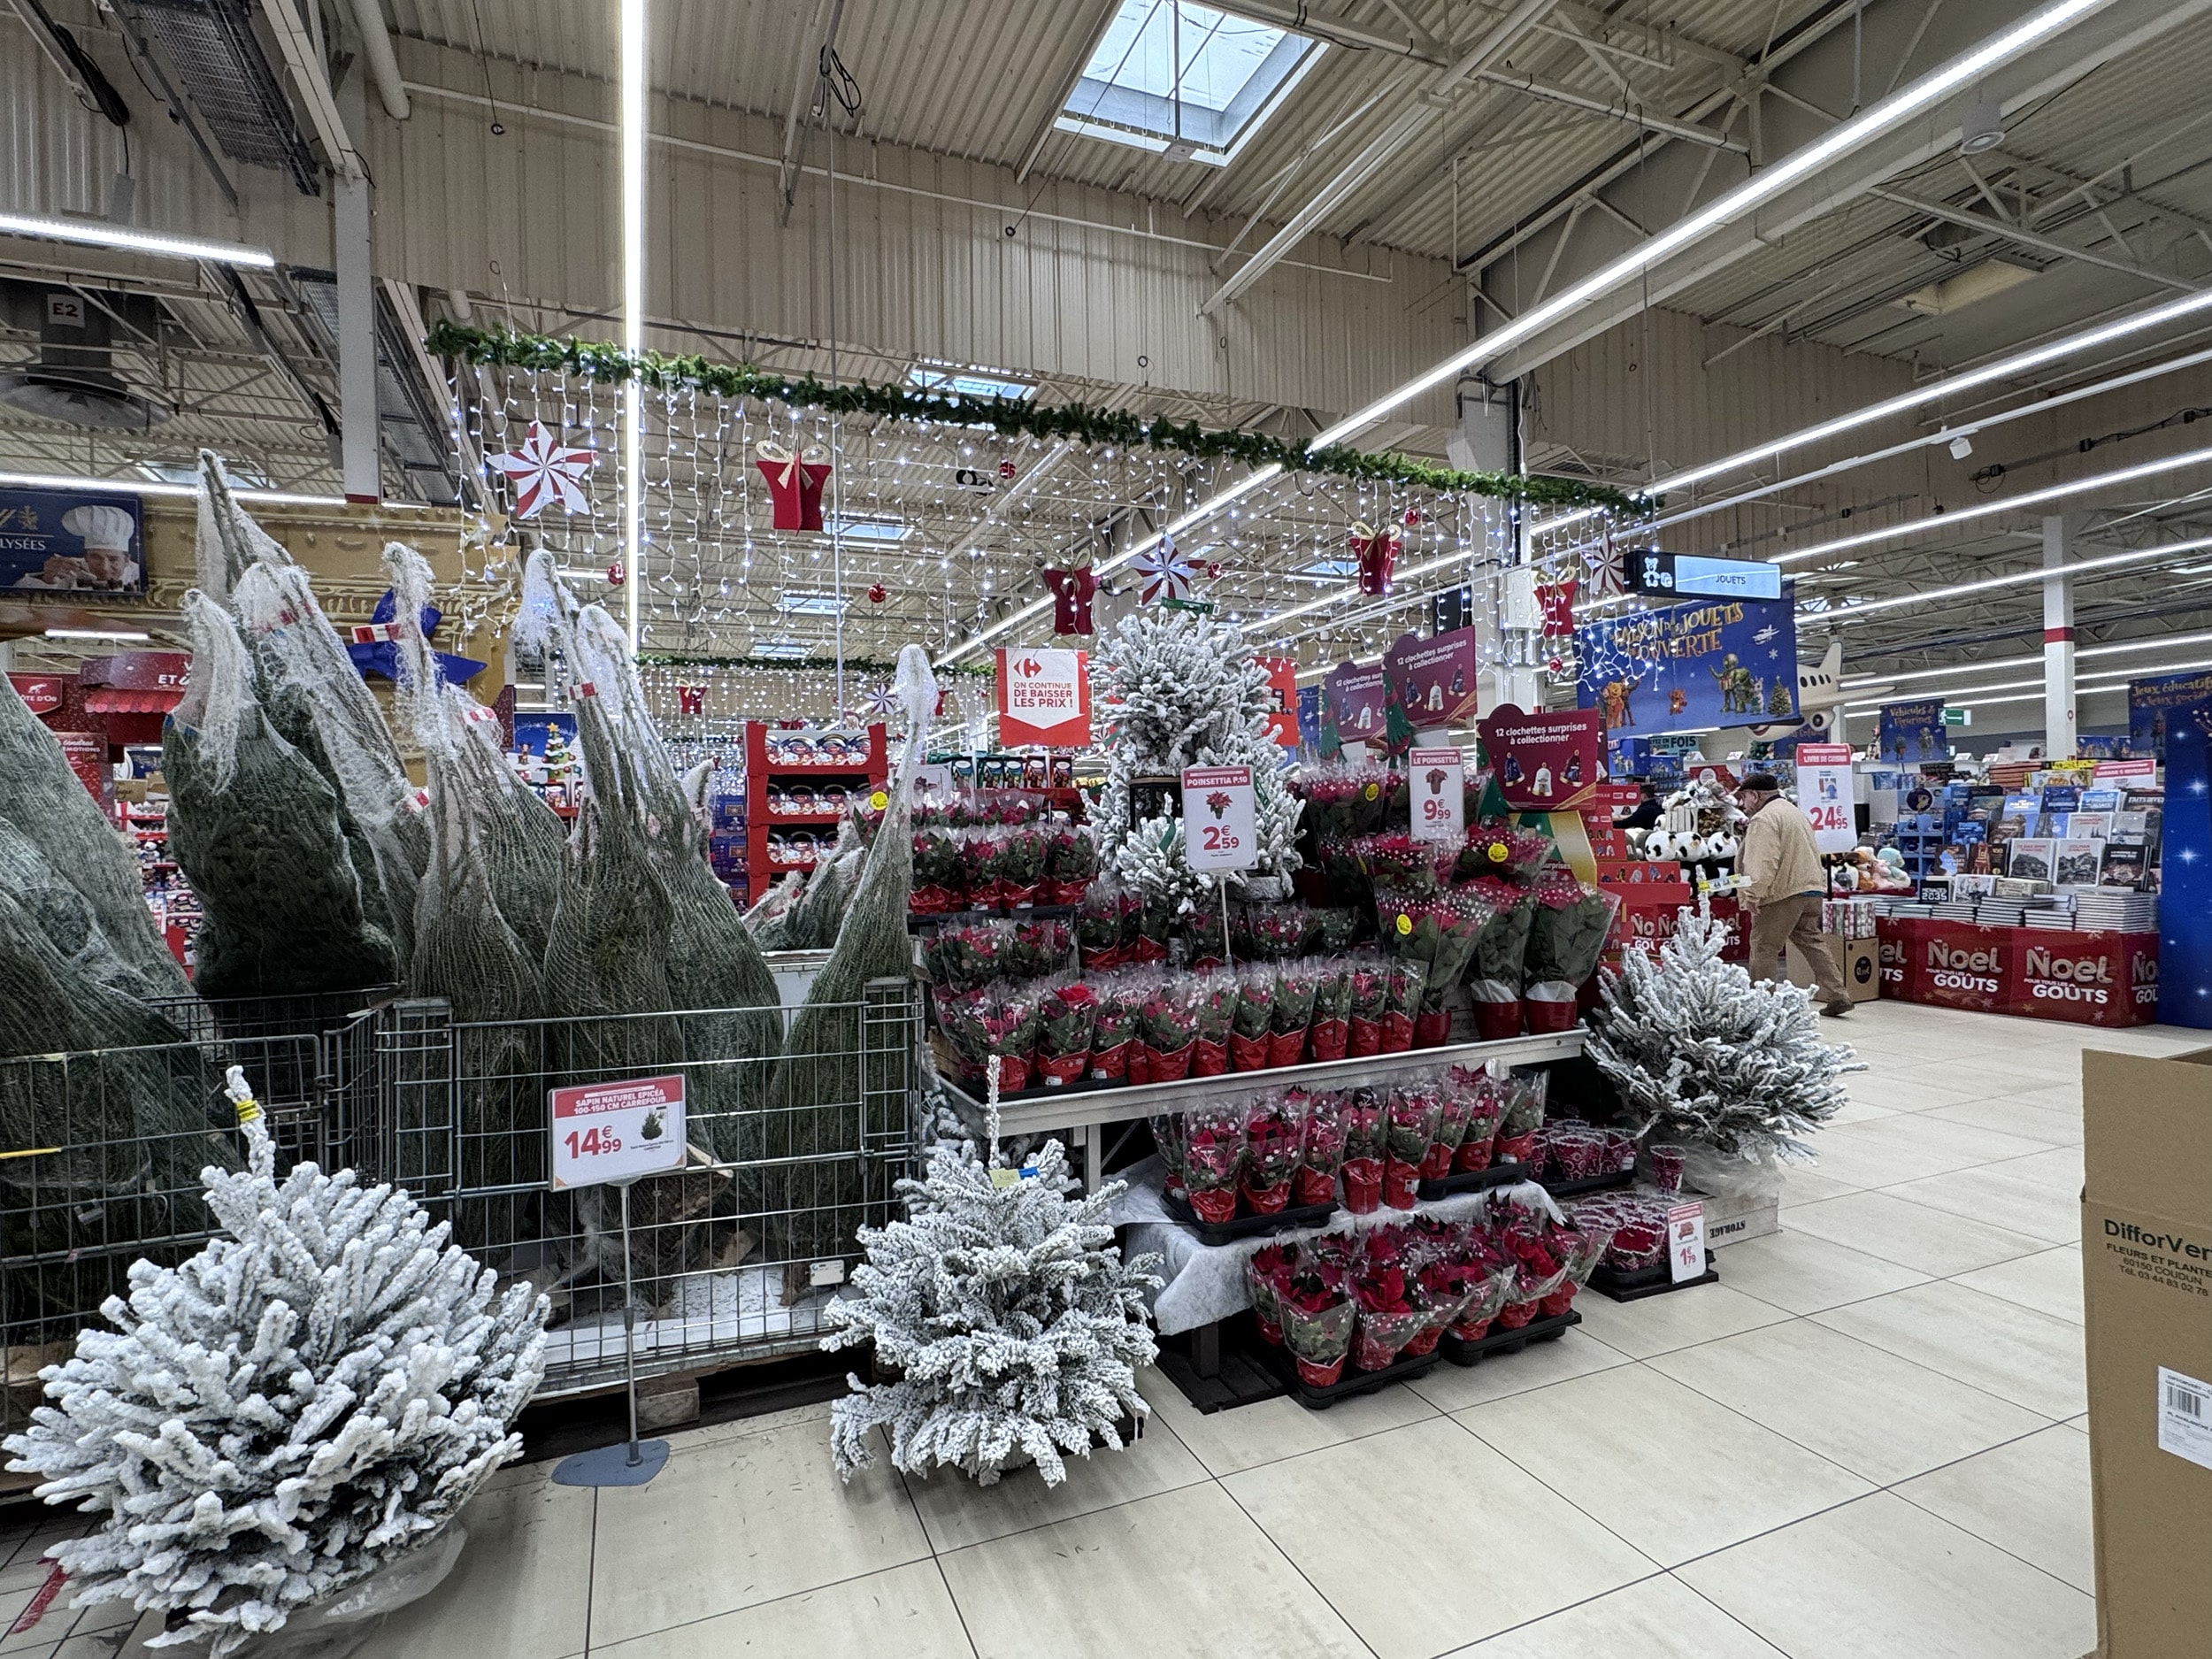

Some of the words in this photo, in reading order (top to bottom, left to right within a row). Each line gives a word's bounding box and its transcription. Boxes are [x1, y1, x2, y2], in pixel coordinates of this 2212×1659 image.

[53, 303, 78, 318] E2
[1716, 574, 1747, 585] JOUETS
[1680, 602, 1744, 635] JOUETS
[1397, 657, 1404, 666] 12
[1404, 648, 1436, 664] clochettes
[1436, 640, 1467, 656] surprises
[1408, 662, 1413, 671] à
[1413, 652, 1454, 670] collectionner
[157, 674, 177, 685] ET
[1342, 673, 1371, 686] clochettes
[20, 694, 35, 703] ÔTE
[2133, 686, 2161, 696] Jeux
[1014, 698, 1035, 708] LES
[1039, 698, 1066, 708] PRIX
[1495, 727, 1504, 737] 12
[1505, 725, 1547, 737] clochettes
[1548, 722, 1587, 736] surprises
[1517, 733, 1570, 745] collectionner
[1671, 736, 1696, 749] FOIS
[1187, 777, 1232, 787] POINSETTIA
[1933, 972, 1999, 993] GOÛTS
[2032, 983, 2108, 1004] GOÛTS
[574, 1105, 606, 1115] 100-150
[620, 1096, 666, 1109] CARREFOUR
[575, 1097, 601, 1108] SAPIN
[602, 1093, 636, 1105] NATUREL
[1709, 1220, 1746, 1239] STORAGE
[2106, 1243, 2148, 1261] FLEURS
[2151, 1255, 2165, 1264] ET
[2123, 1256, 2153, 1271] 60150
[2154, 1265, 2203, 1286] COUDUN
[2138, 1271, 2150, 1280] 03
[2152, 1274, 2164, 1284] 44
[2166, 1278, 2178, 1288] 83
[2181, 1282, 2193, 1293] 02
